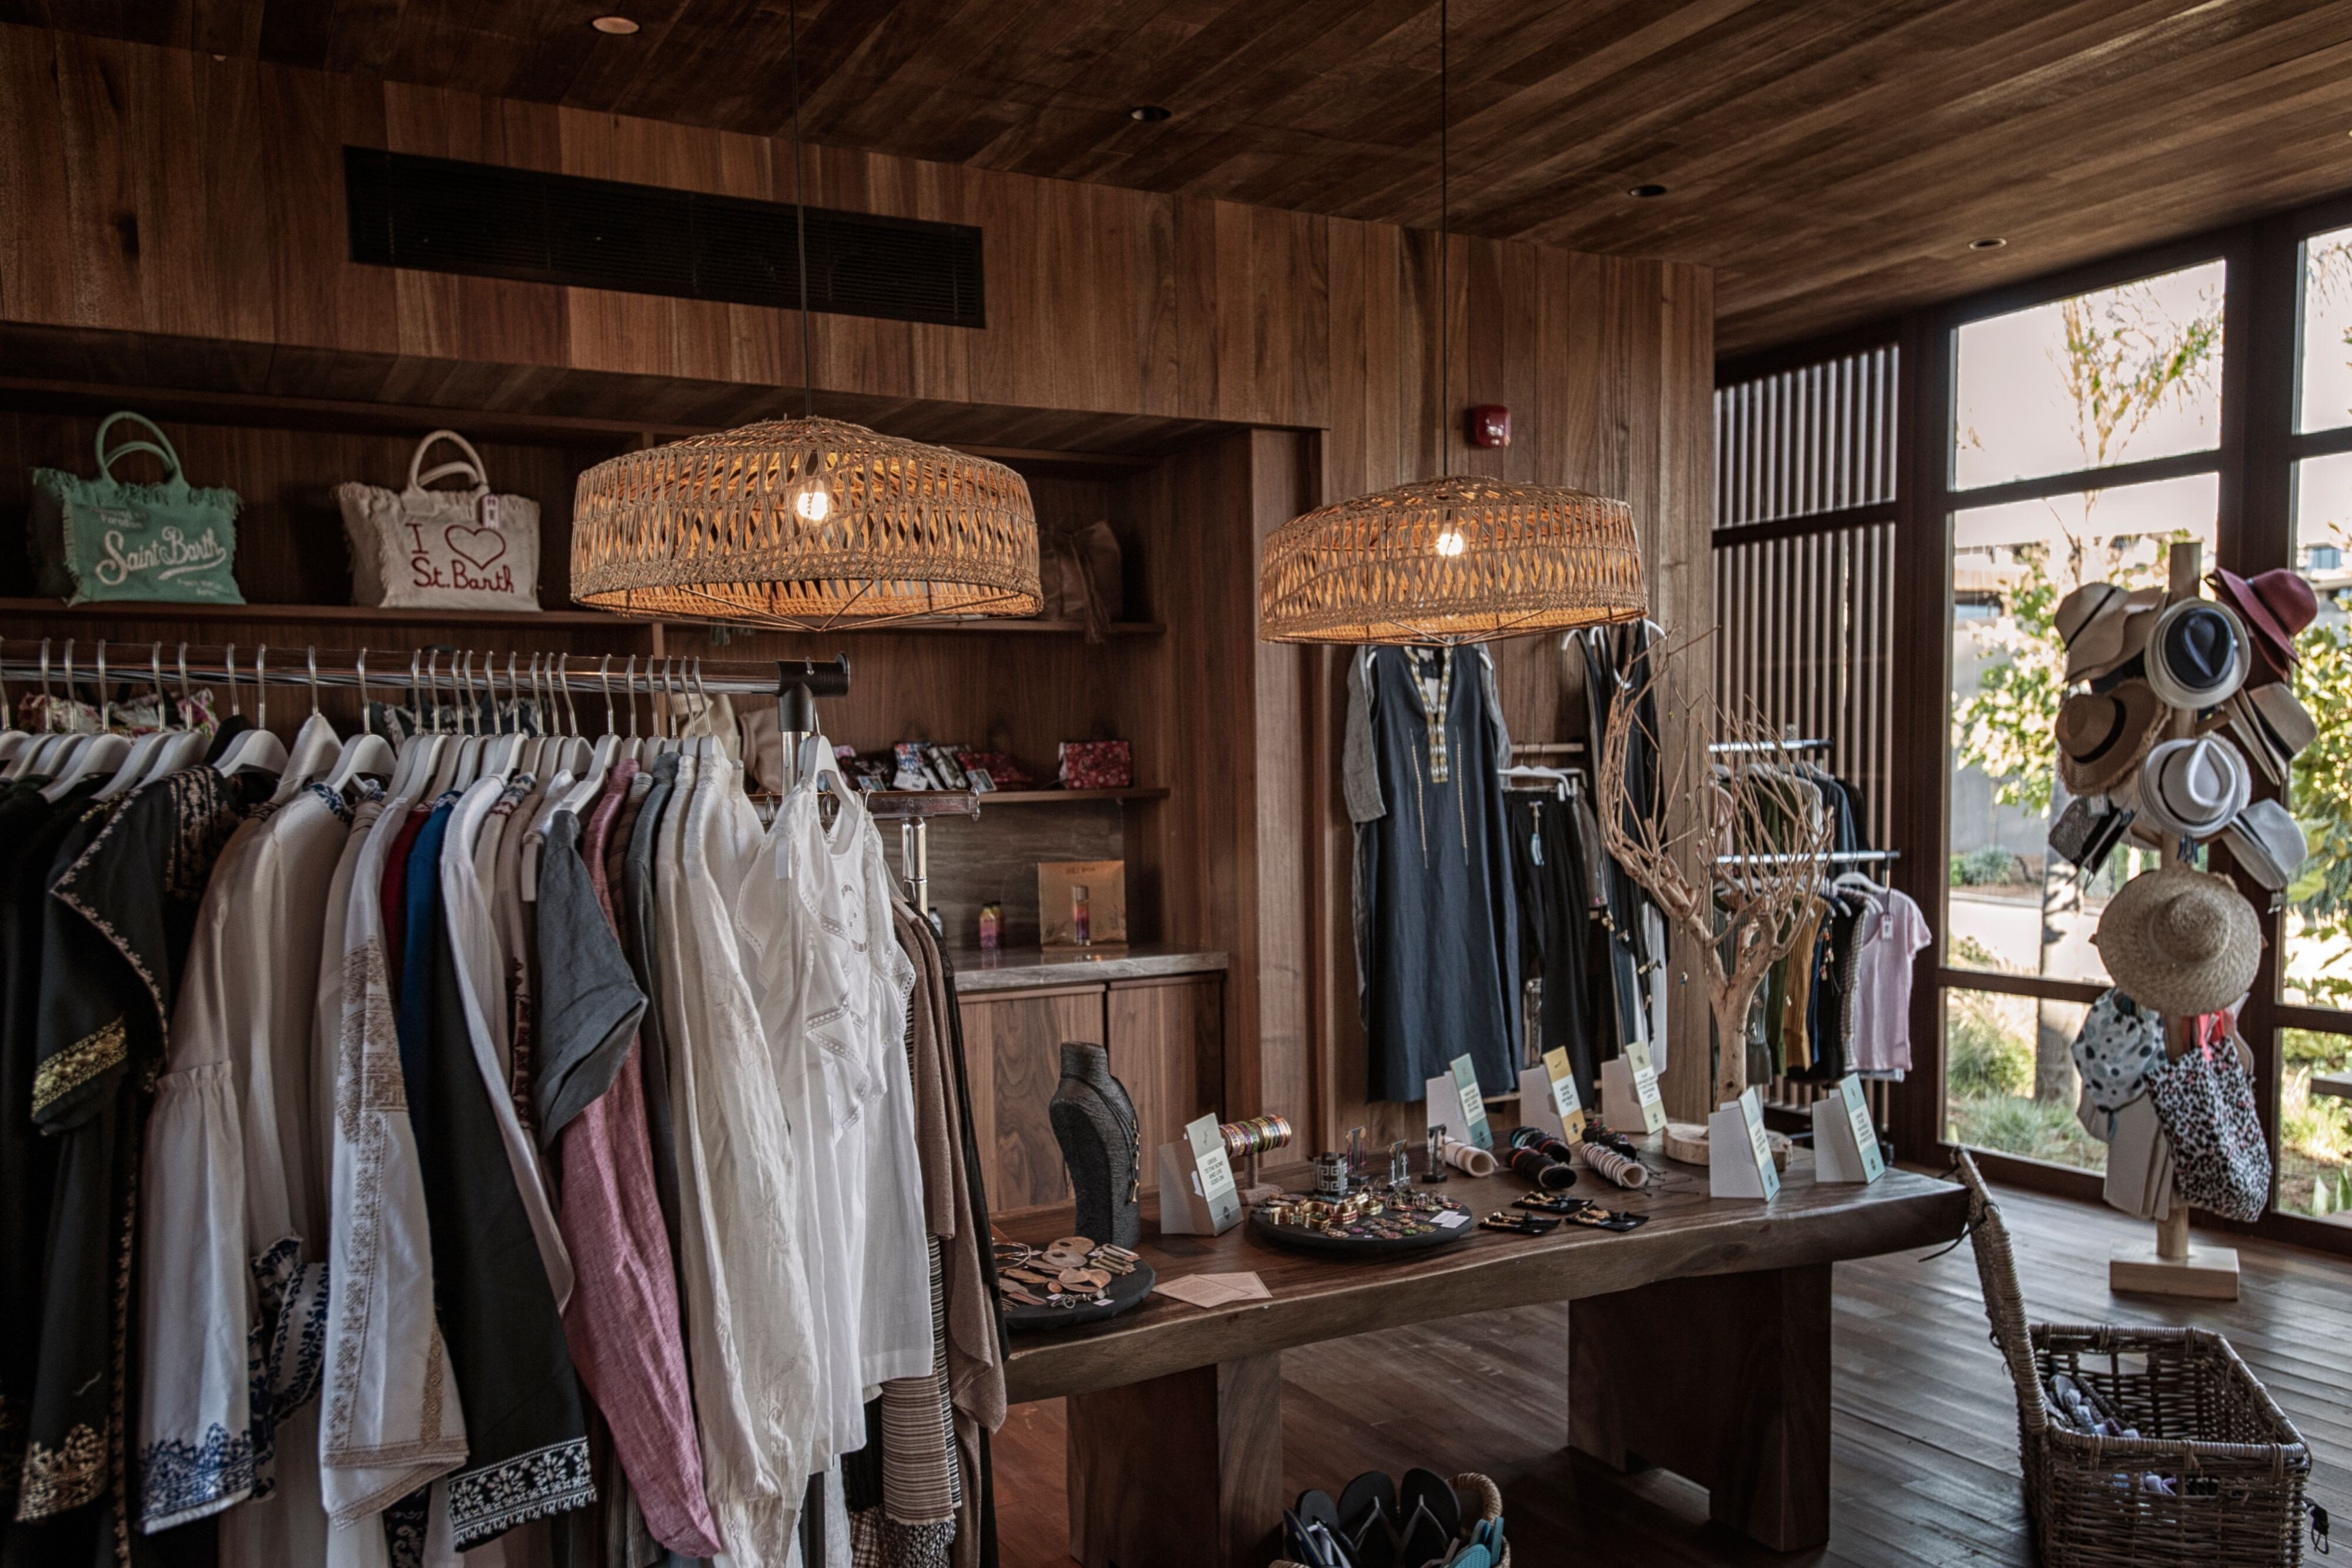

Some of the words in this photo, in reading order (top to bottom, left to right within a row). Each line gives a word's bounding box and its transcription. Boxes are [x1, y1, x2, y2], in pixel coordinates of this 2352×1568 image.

[95, 529, 161, 586] Saint
[159, 525, 227, 580] Barth
[405, 521, 429, 554] I
[410, 556, 451, 588] St.
[451, 559, 514, 594] Barth
